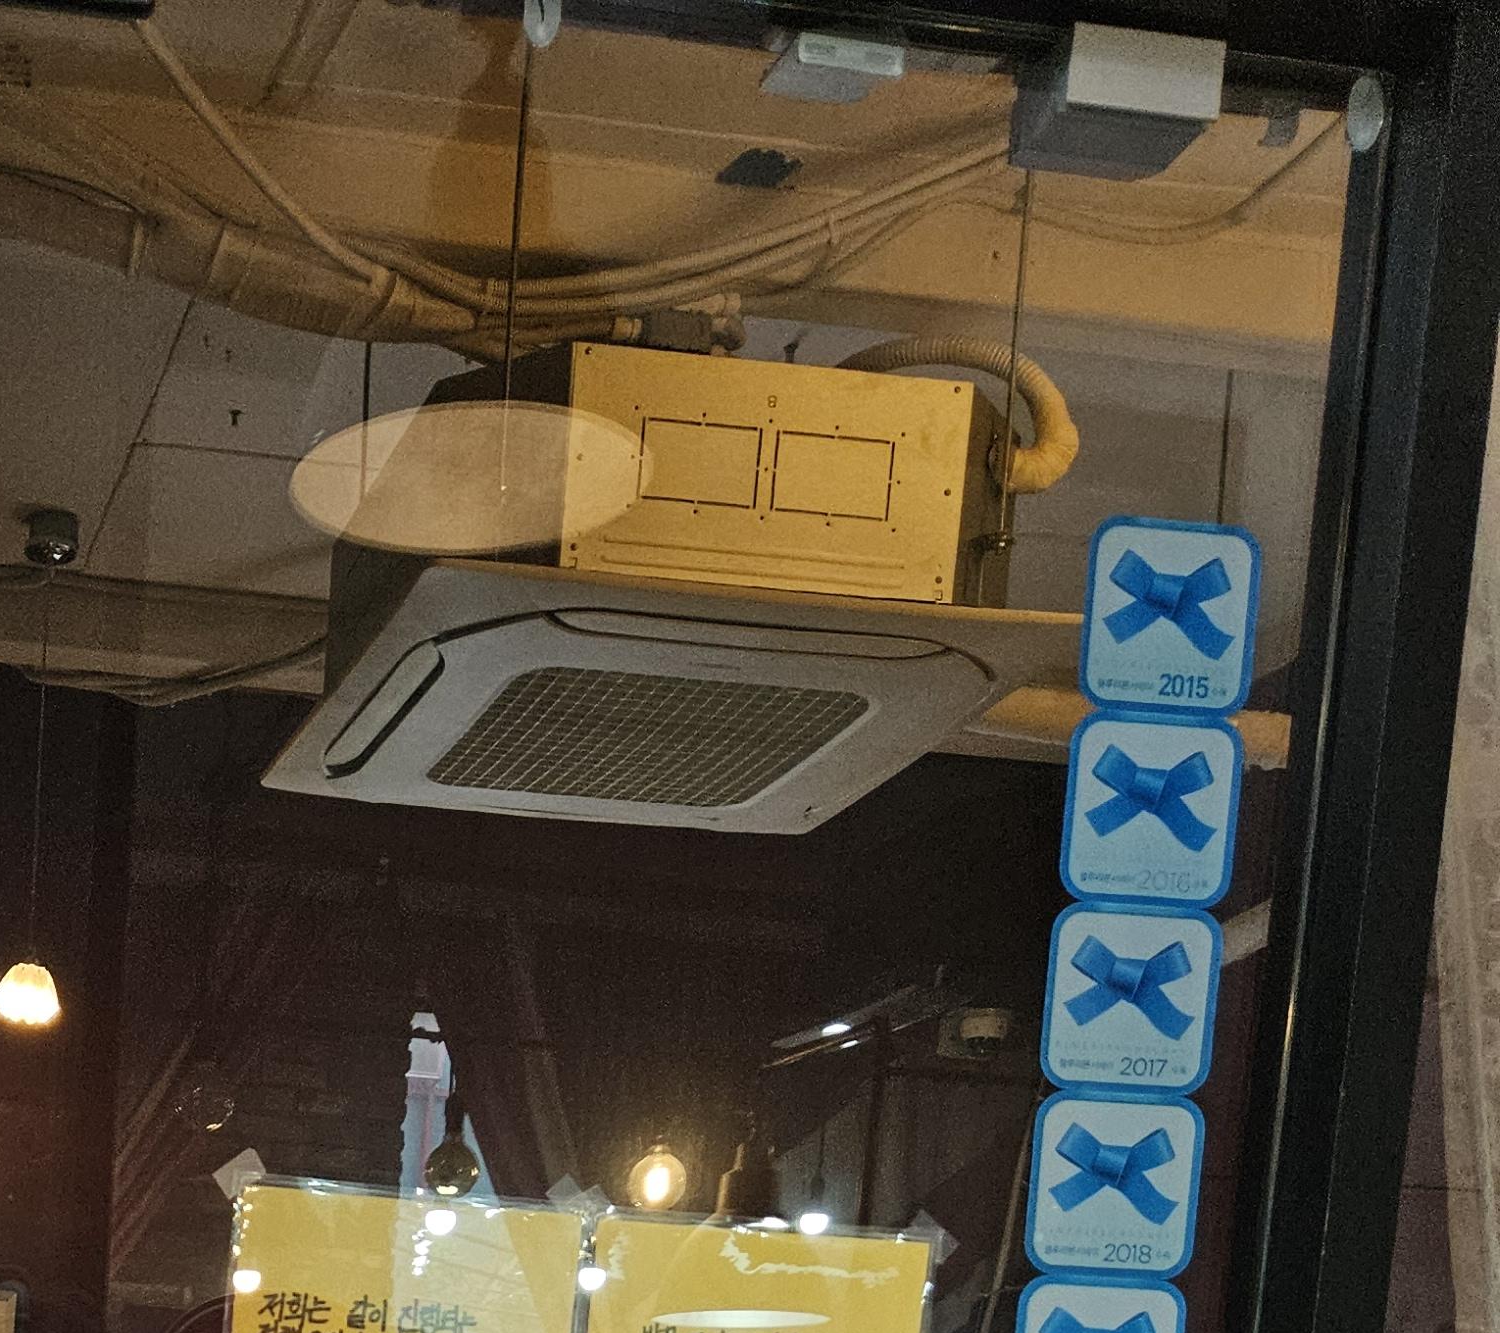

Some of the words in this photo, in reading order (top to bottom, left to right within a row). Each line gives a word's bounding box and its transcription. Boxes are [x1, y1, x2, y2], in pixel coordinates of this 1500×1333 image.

[1158, 673, 1209, 699] 2015
[1120, 1057, 1168, 1077] 2017
[1103, 1243, 1152, 1264] 2018
[258, 1292, 331, 1326] 저희는
[347, 1295, 387, 1332] 같이
